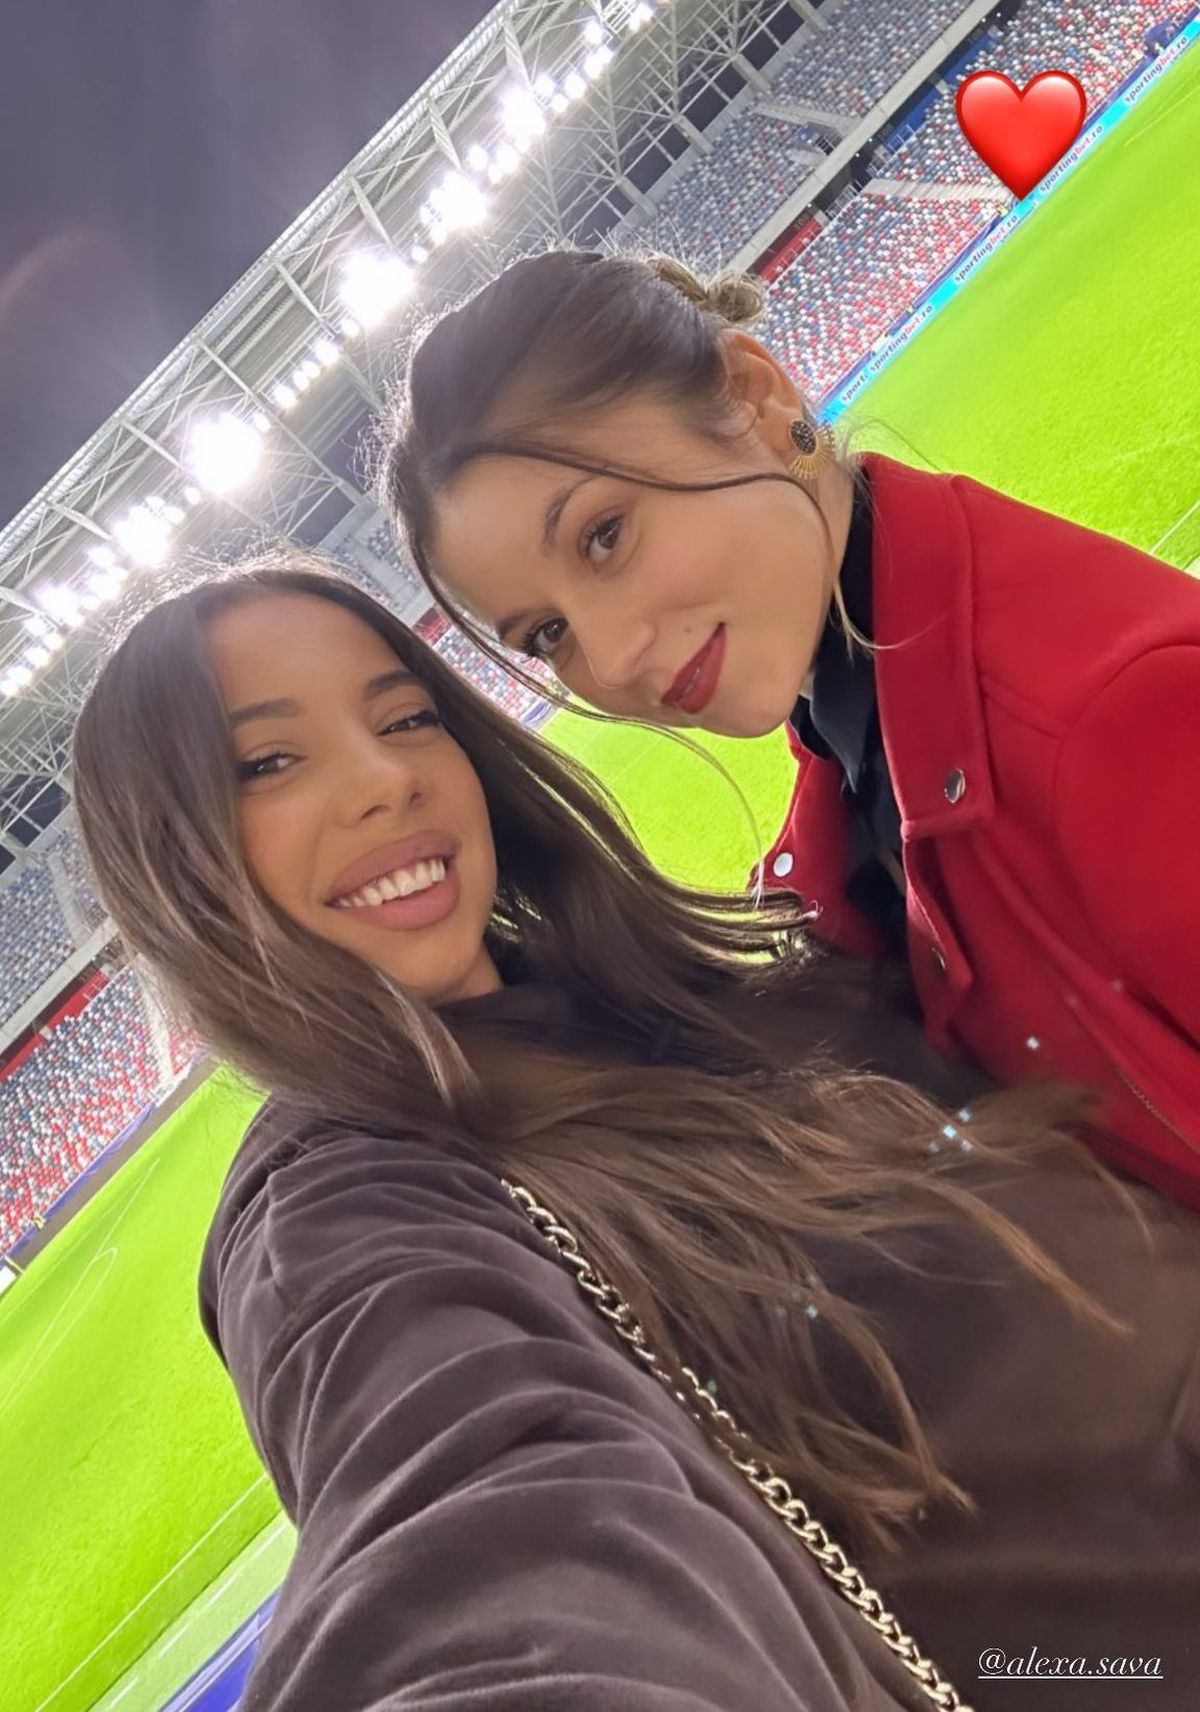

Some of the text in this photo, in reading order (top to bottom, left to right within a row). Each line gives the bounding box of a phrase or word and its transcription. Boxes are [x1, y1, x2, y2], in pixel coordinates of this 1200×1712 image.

[1125, 37, 1188, 103] sportingbet.ro
[1040, 126, 1103, 192] sportingbet.ro
[955, 215, 1018, 283] sportingbet.ro
[871, 305, 933, 372] sportingbet.ro
